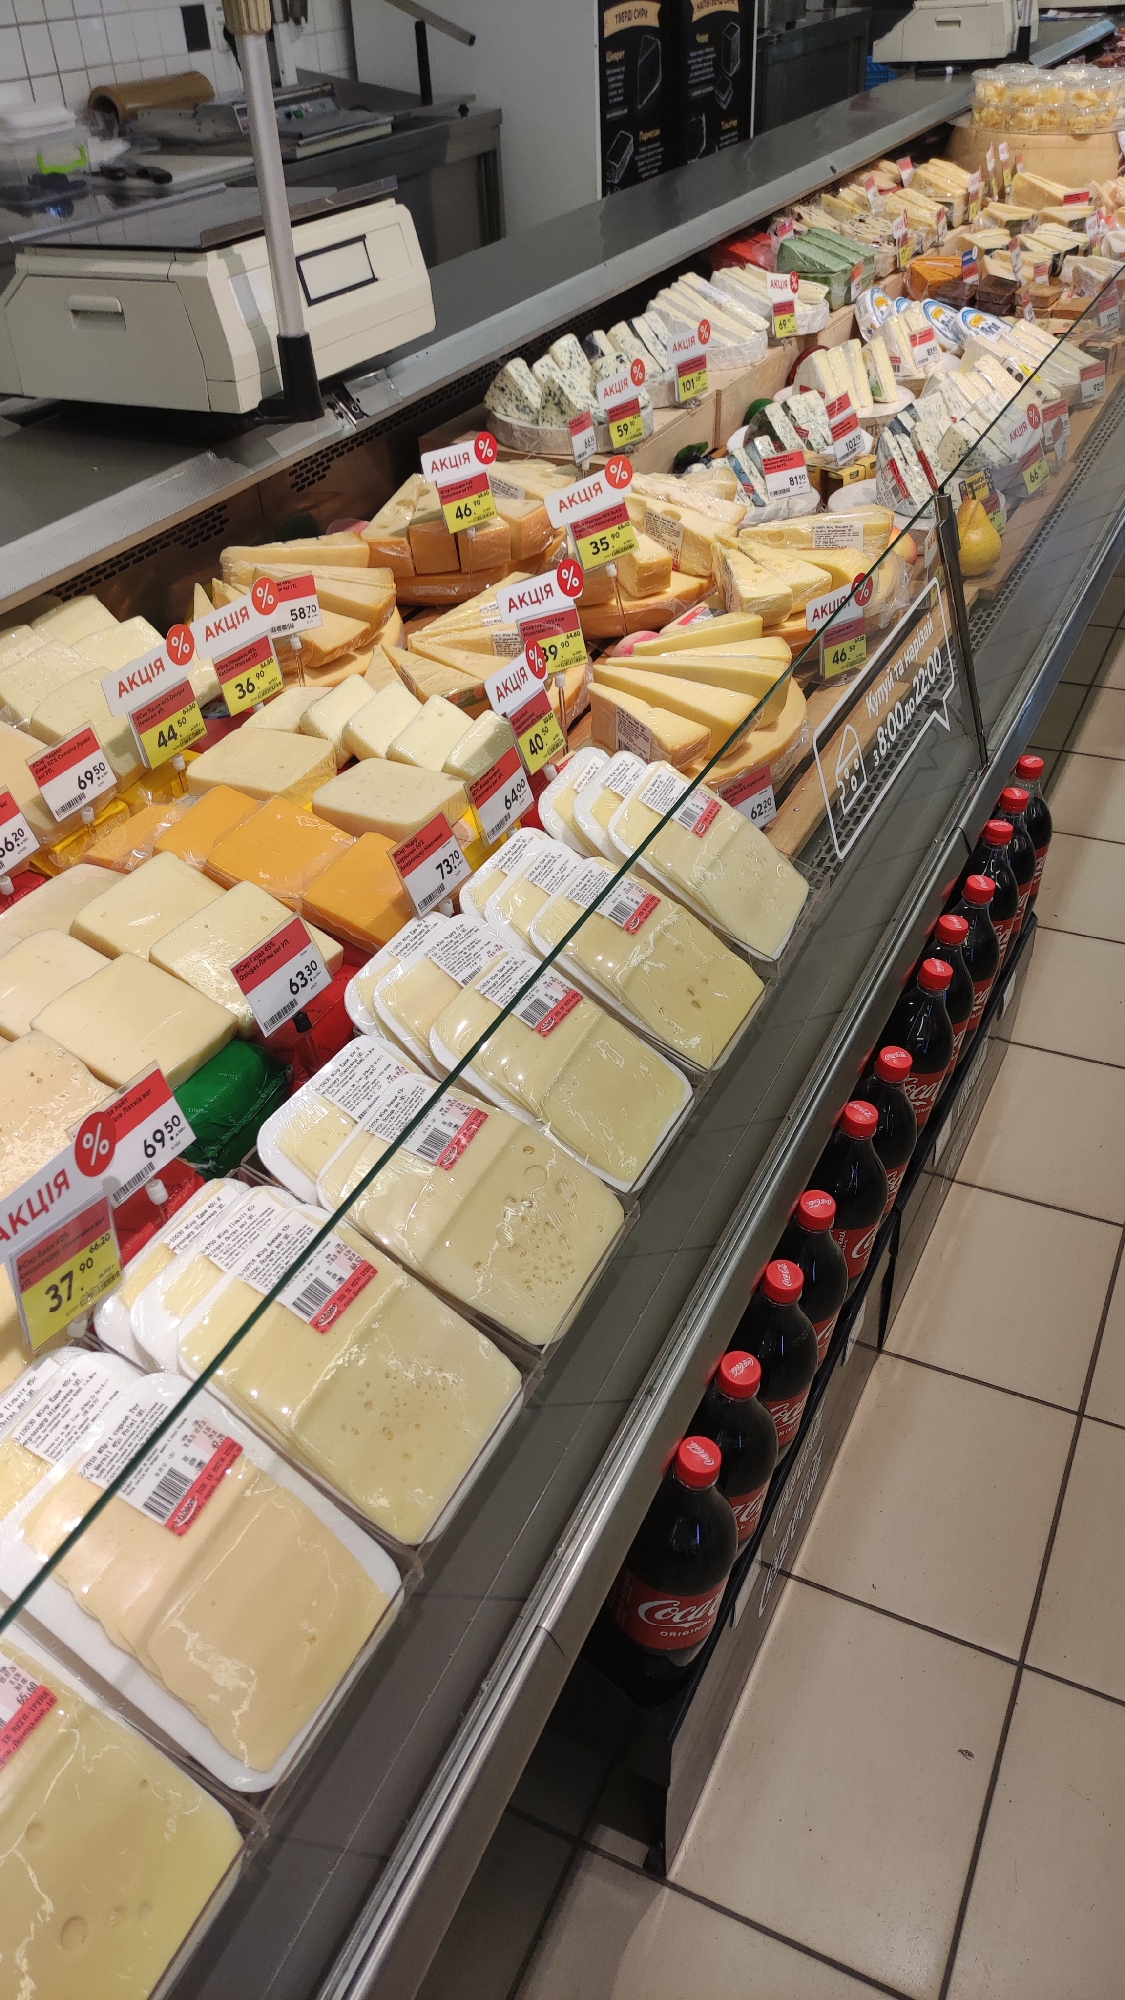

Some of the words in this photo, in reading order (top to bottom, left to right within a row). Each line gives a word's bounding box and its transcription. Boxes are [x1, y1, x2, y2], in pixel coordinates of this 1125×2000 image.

[672, 339, 696, 353] АКЦІЯ
[604, 378, 628, 398] АКЦІЯ
[1009, 422, 1028, 444] АКЦІЯ
[431, 452, 470, 473] АКЦІЯ
[559, 482, 603, 513] АКЦІЯ
[508, 583, 554, 613] АКЦІЯ
[206, 606, 250, 642] АКЦІЯ
[290, 605, 317, 622] 58.70
[118, 657, 166, 700] АКЦІЯ
[865, 667, 895, 719] Купуй
[894, 660, 905, 676] та
[904, 612, 934, 668] нарізай
[496, 666, 528, 703] АКЦІЯ
[876, 700, 904, 757] 8:00
[904, 696, 916, 721] до
[912, 646, 942, 705] 22:00
[78, 762, 106, 790] 69.50
[505, 778, 526, 810] 64.00
[436, 850, 460, 880] 73.70
[234, 960, 251, 975] #Сир
[290, 960, 318, 995] 63.30
[143, 1114, 181, 1158] 69.50
[0, 1168, 70, 1241] АКЦІЯ
[25, 1375, 37, 1387] 45%
[48, 1388, 62, 1403] Едам
[15, 1680, 38, 1705] 65,60
